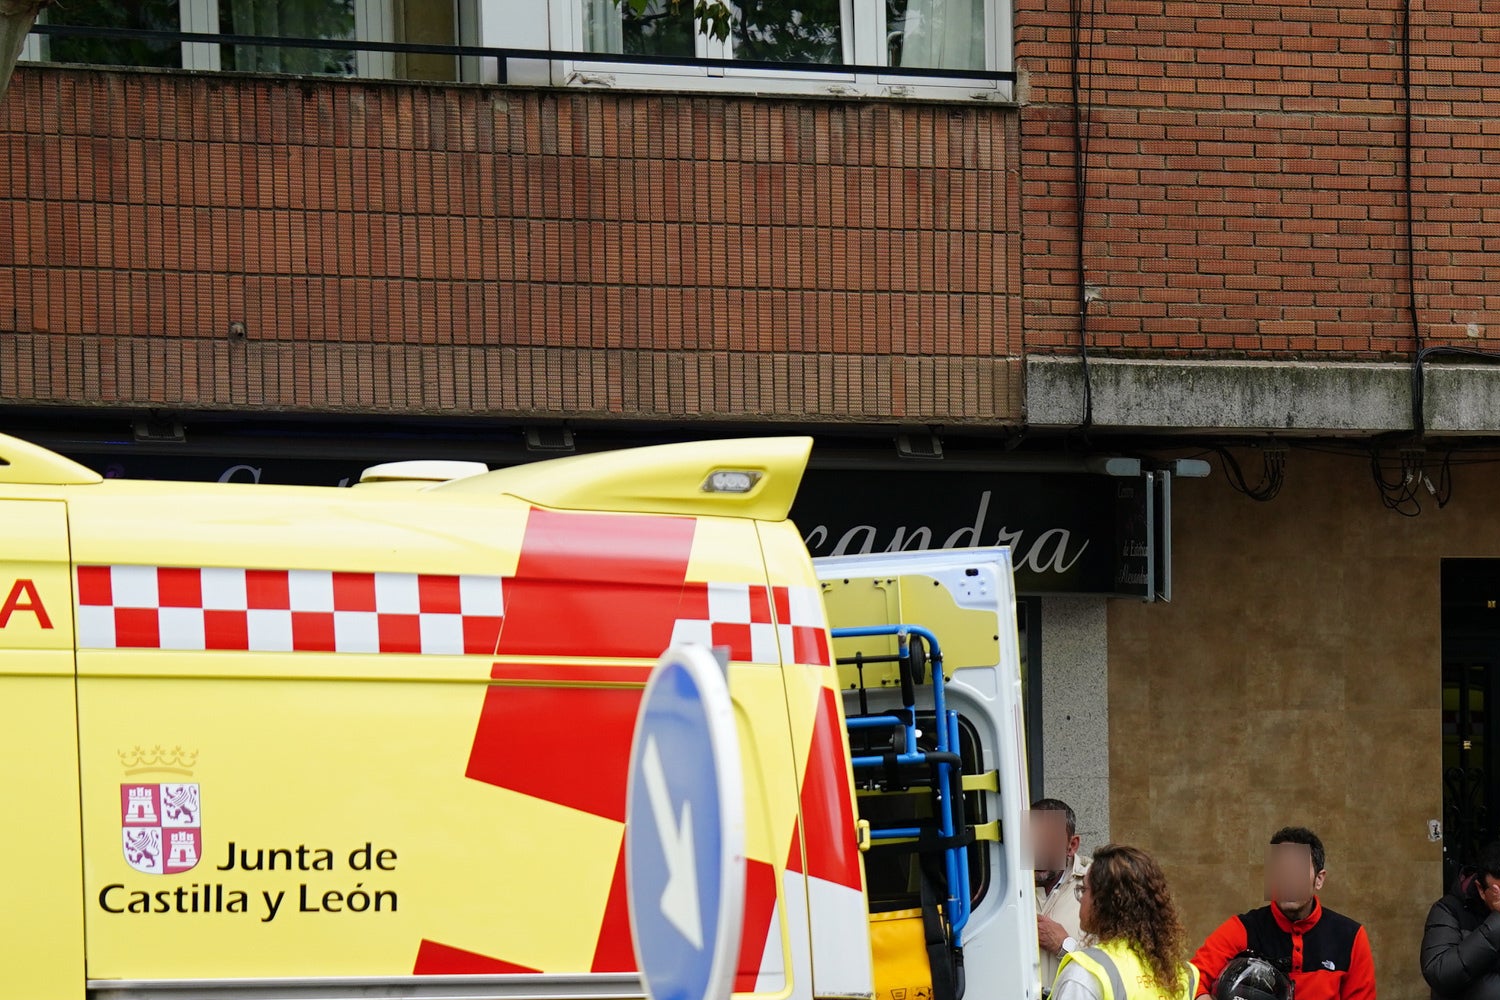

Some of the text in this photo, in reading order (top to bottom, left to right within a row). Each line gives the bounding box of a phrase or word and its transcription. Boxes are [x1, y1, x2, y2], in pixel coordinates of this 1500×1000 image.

[217, 841, 398, 871] Junta de
[98, 882, 397, 923] Castilla y León
